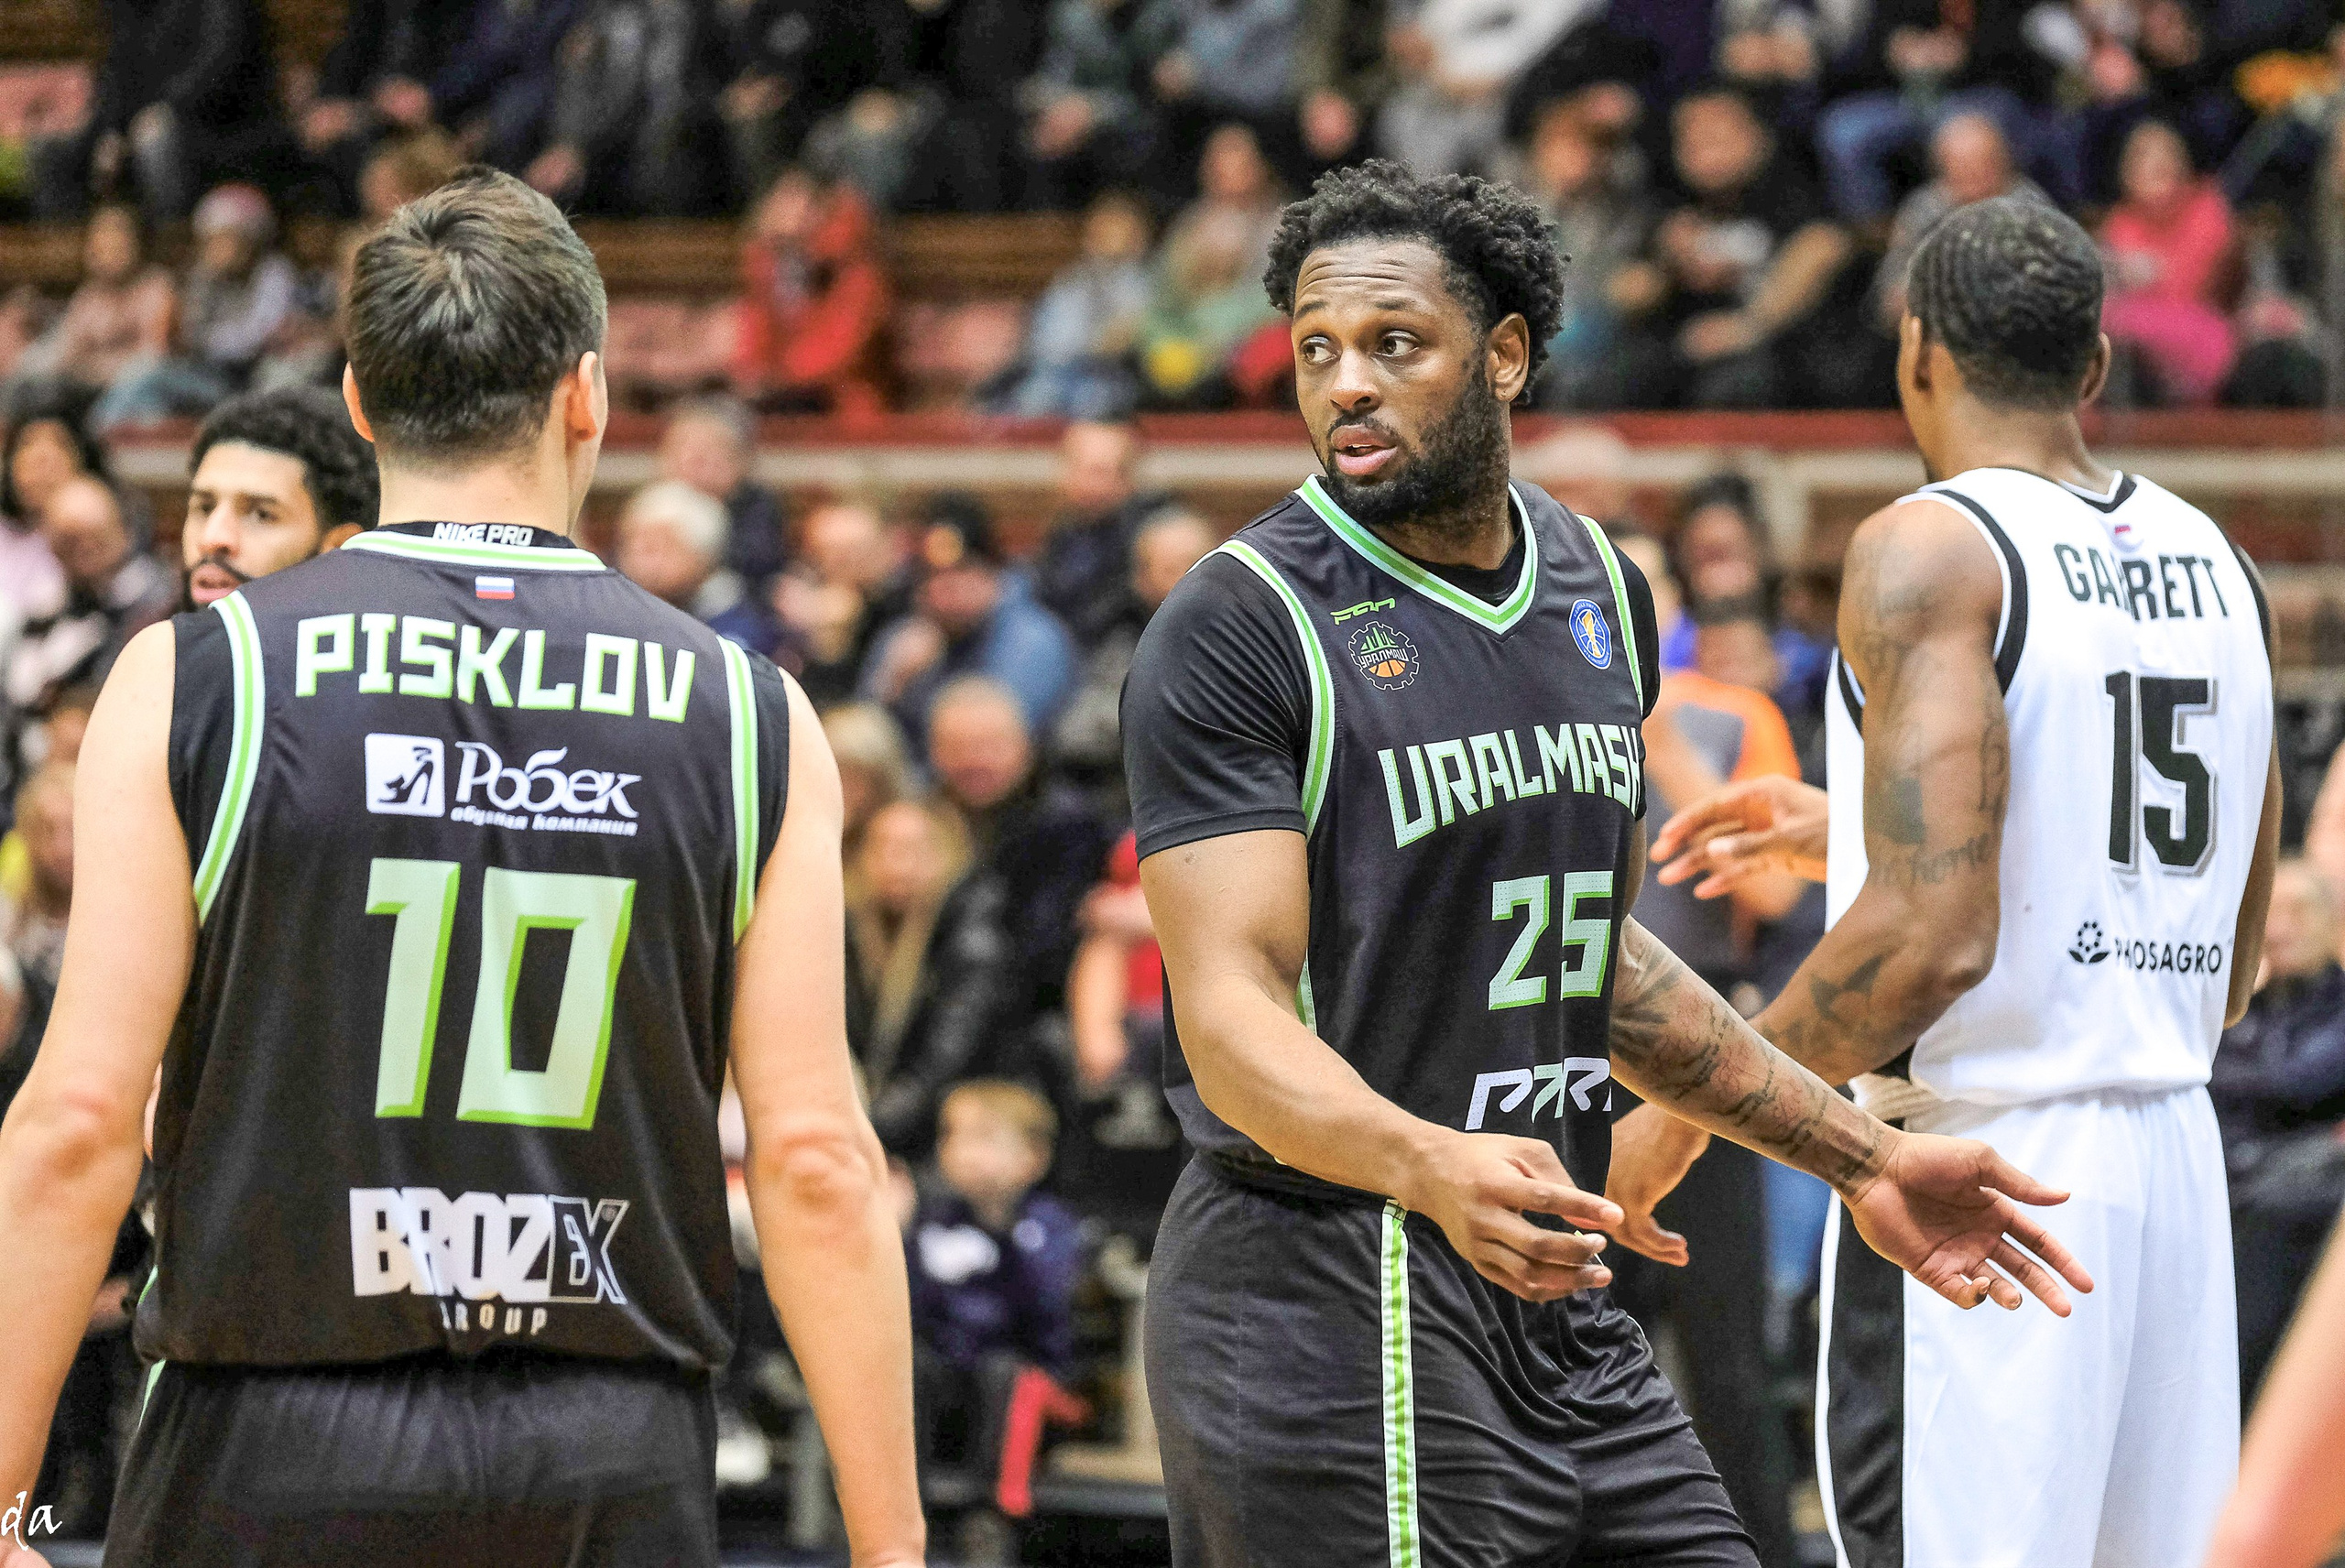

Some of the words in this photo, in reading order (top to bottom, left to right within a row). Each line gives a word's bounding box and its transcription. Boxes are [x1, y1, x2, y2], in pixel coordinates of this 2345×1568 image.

[433, 522, 487, 543] NIKE
[485, 524, 535, 547] PRO
[2053, 543, 2228, 621] GARETT
[295, 613, 695, 723] PISKLOV
[1358, 648, 1410, 670] УРАЛМАШ
[454, 740, 641, 819] Робек
[532, 812, 638, 837] компания
[1377, 723, 1641, 849] URALMASH
[2106, 670, 2218, 877] 15
[365, 857, 637, 1131] 10
[1489, 870, 1613, 1010] 25
[349, 1187, 630, 1305] BROZEX
